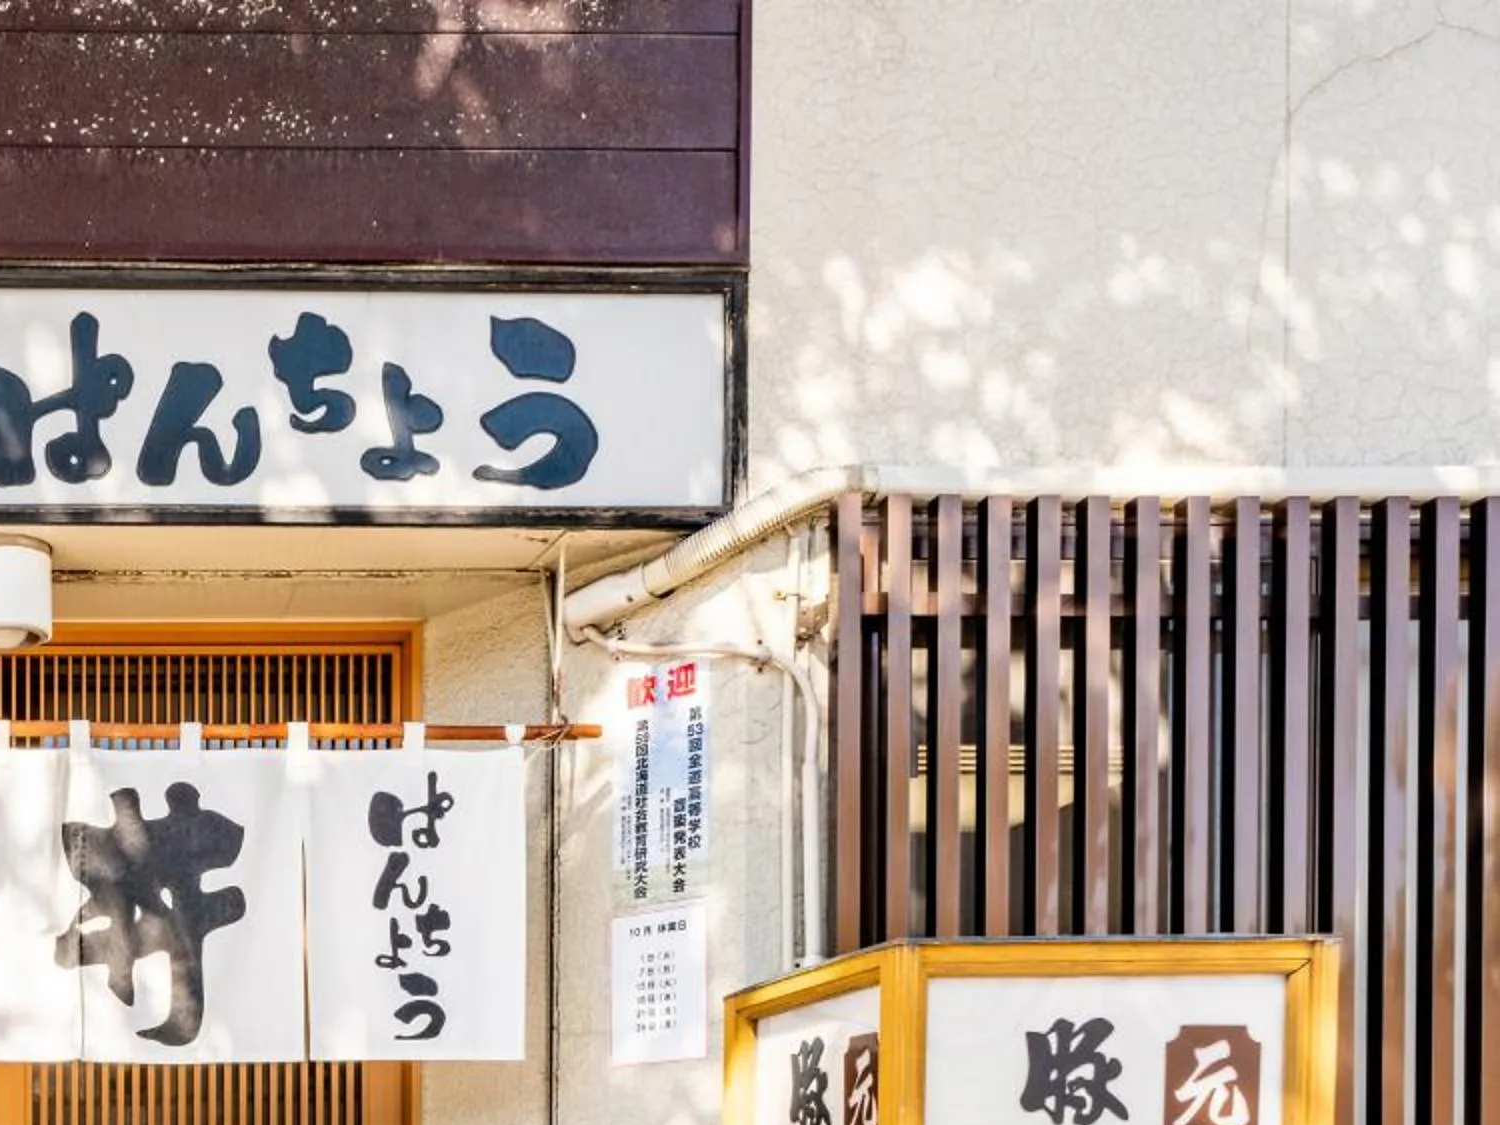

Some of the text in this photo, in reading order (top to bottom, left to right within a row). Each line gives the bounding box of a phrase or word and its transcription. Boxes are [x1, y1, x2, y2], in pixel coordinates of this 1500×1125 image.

[368, 771, 455, 1042] ぱんちょう
